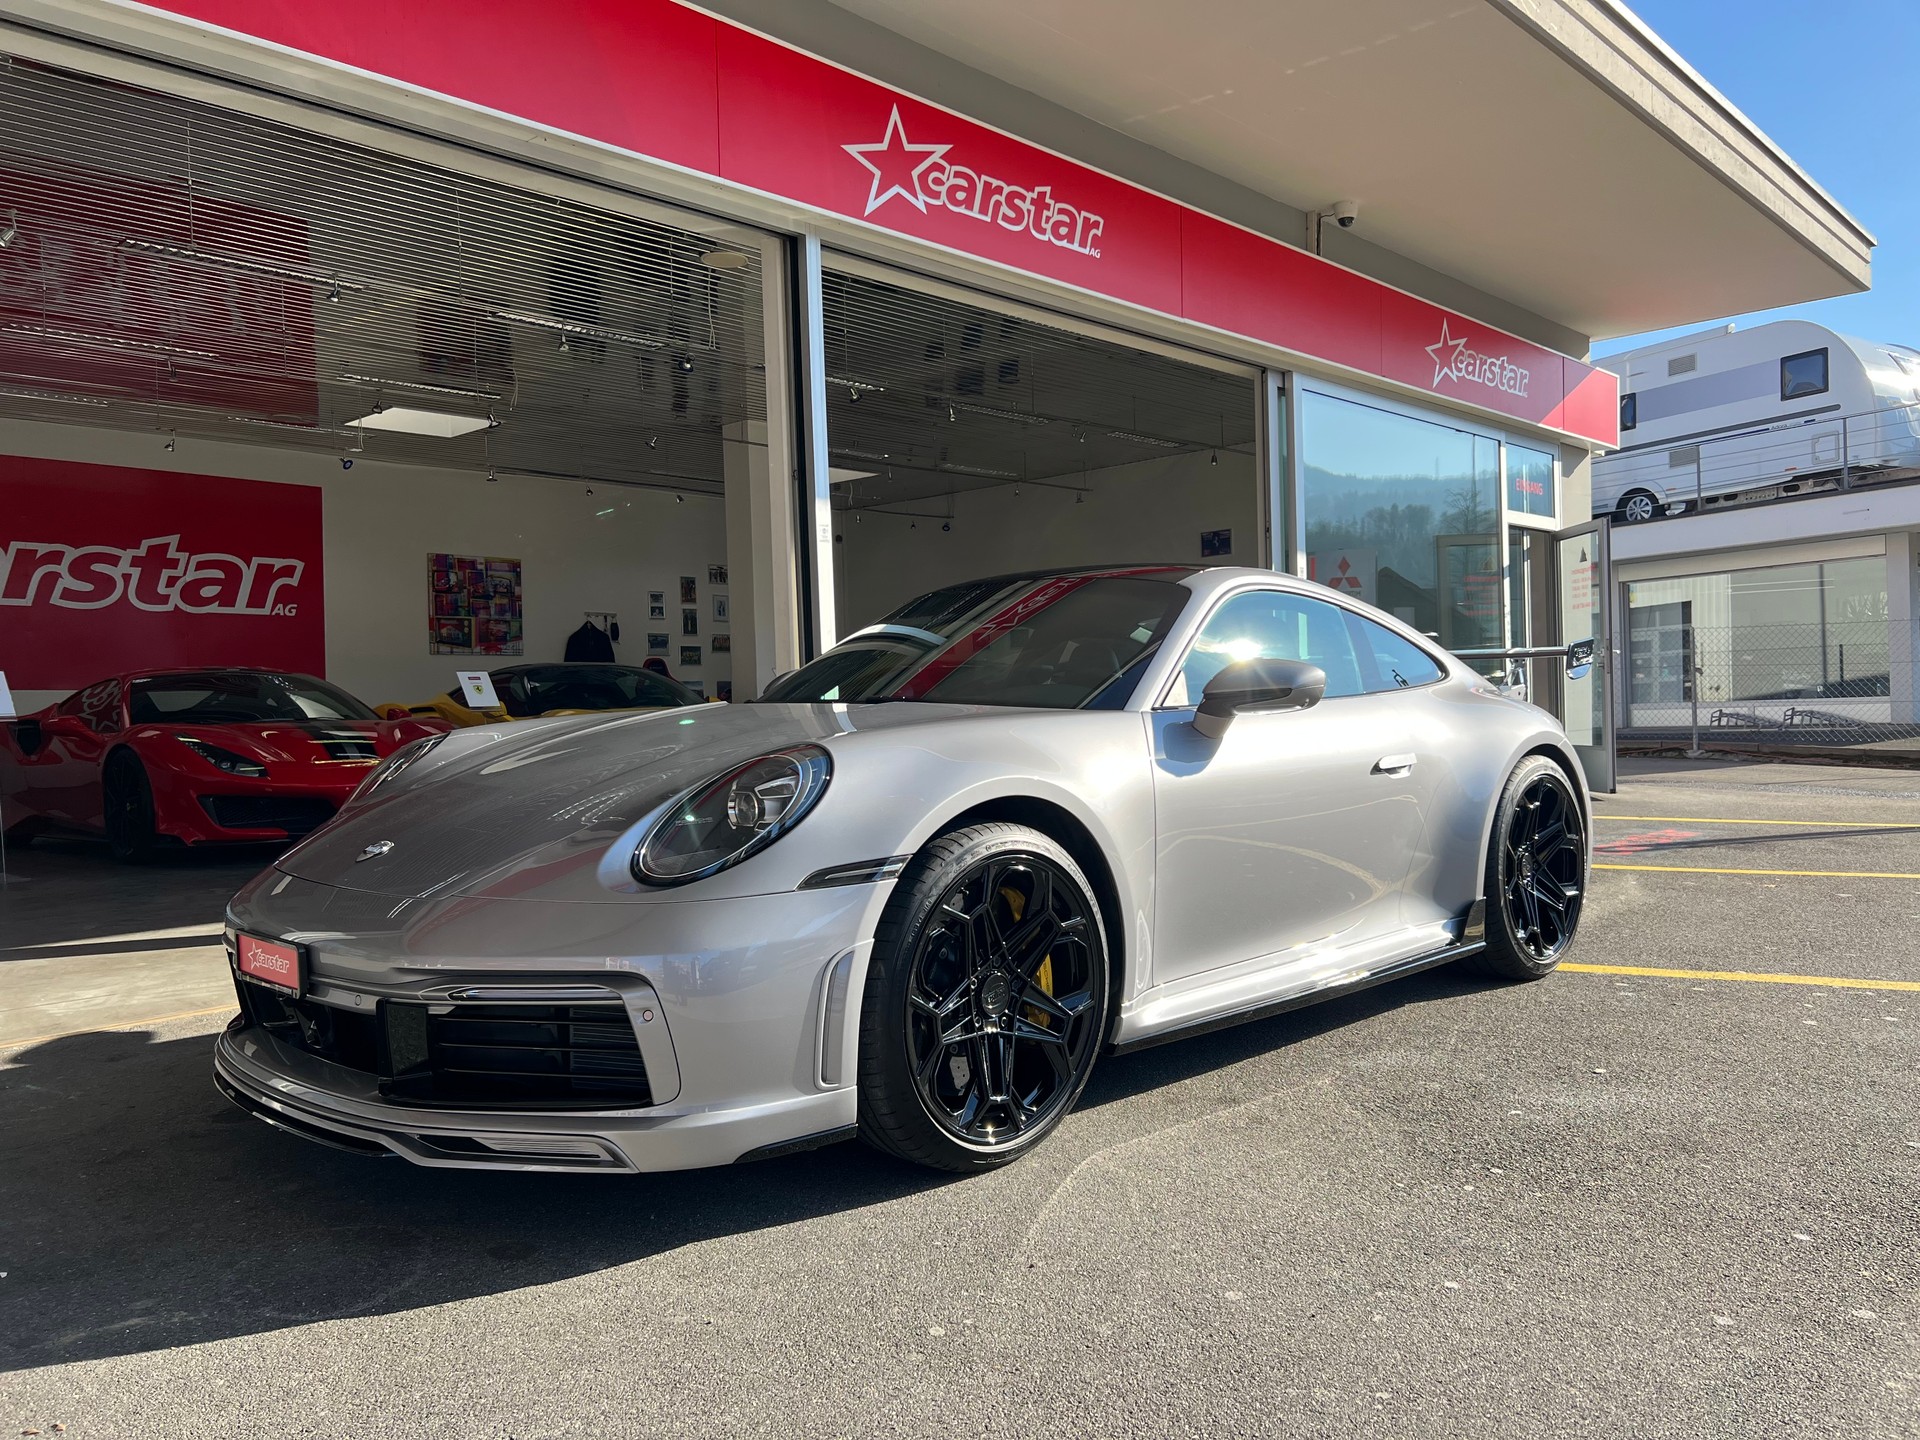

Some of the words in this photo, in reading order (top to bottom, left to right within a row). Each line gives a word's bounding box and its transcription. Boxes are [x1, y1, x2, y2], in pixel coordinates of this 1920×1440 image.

[912, 158, 1104, 254] carstar
[1089, 247, 1101, 259] AG
[1452, 346, 1529, 395] carstar
[0, 534, 304, 615] rstar
[271, 603, 297, 616] AG
[257, 953, 290, 973] carstar
